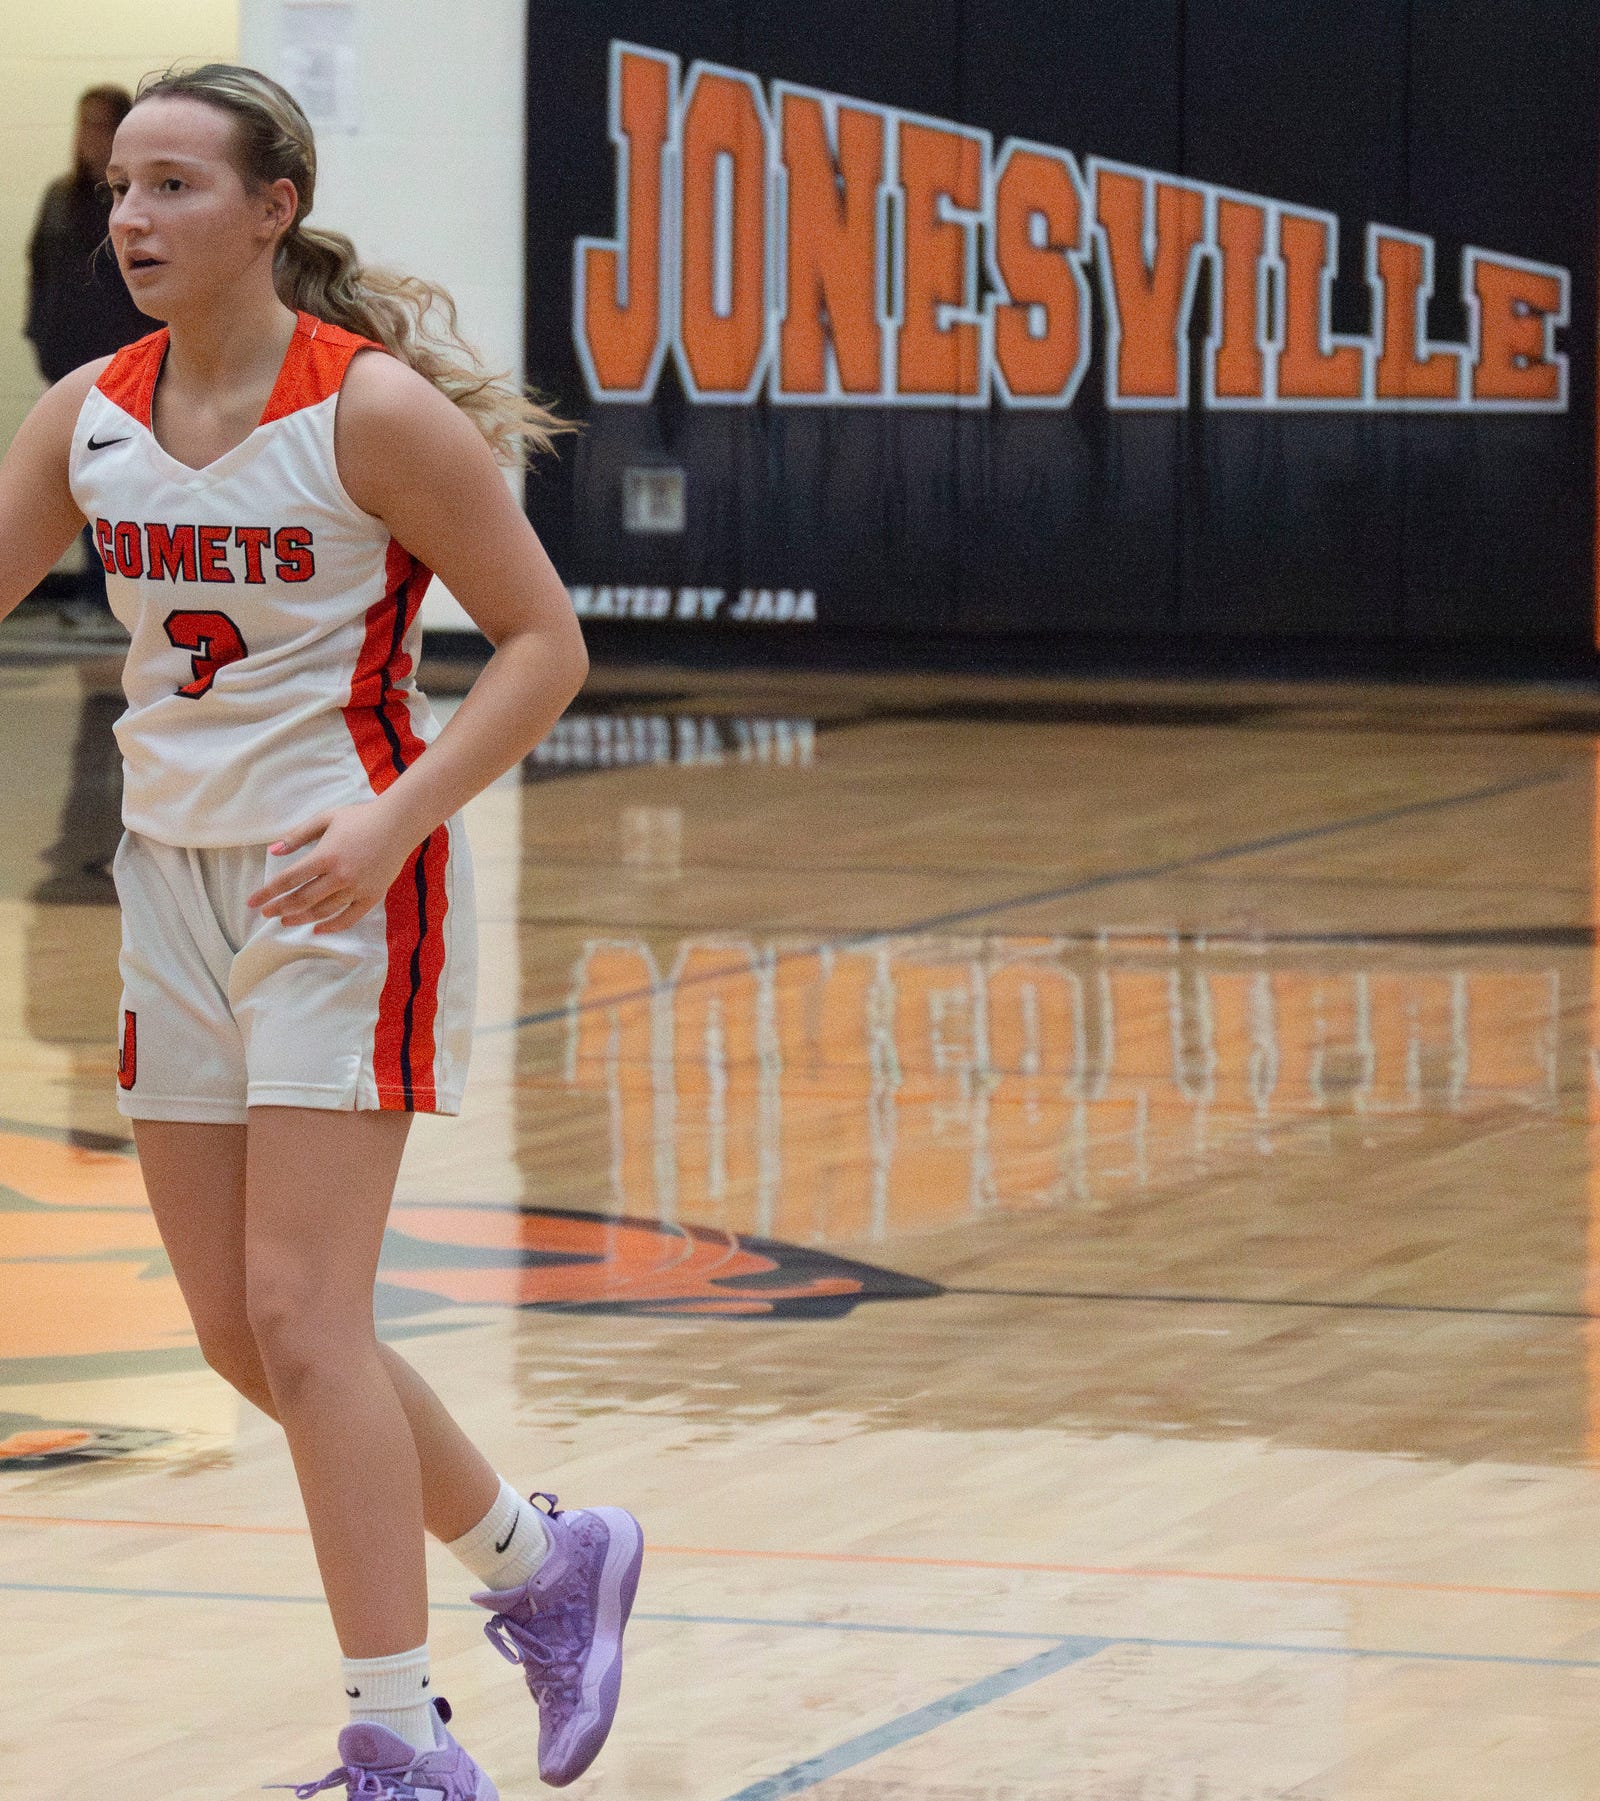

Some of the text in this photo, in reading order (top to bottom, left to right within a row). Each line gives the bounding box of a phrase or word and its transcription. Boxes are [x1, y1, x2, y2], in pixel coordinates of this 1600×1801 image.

[573, 38, 1570, 412] JONESVILLE
[95, 517, 315, 584] COMETS
[163, 609, 248, 699] 3
